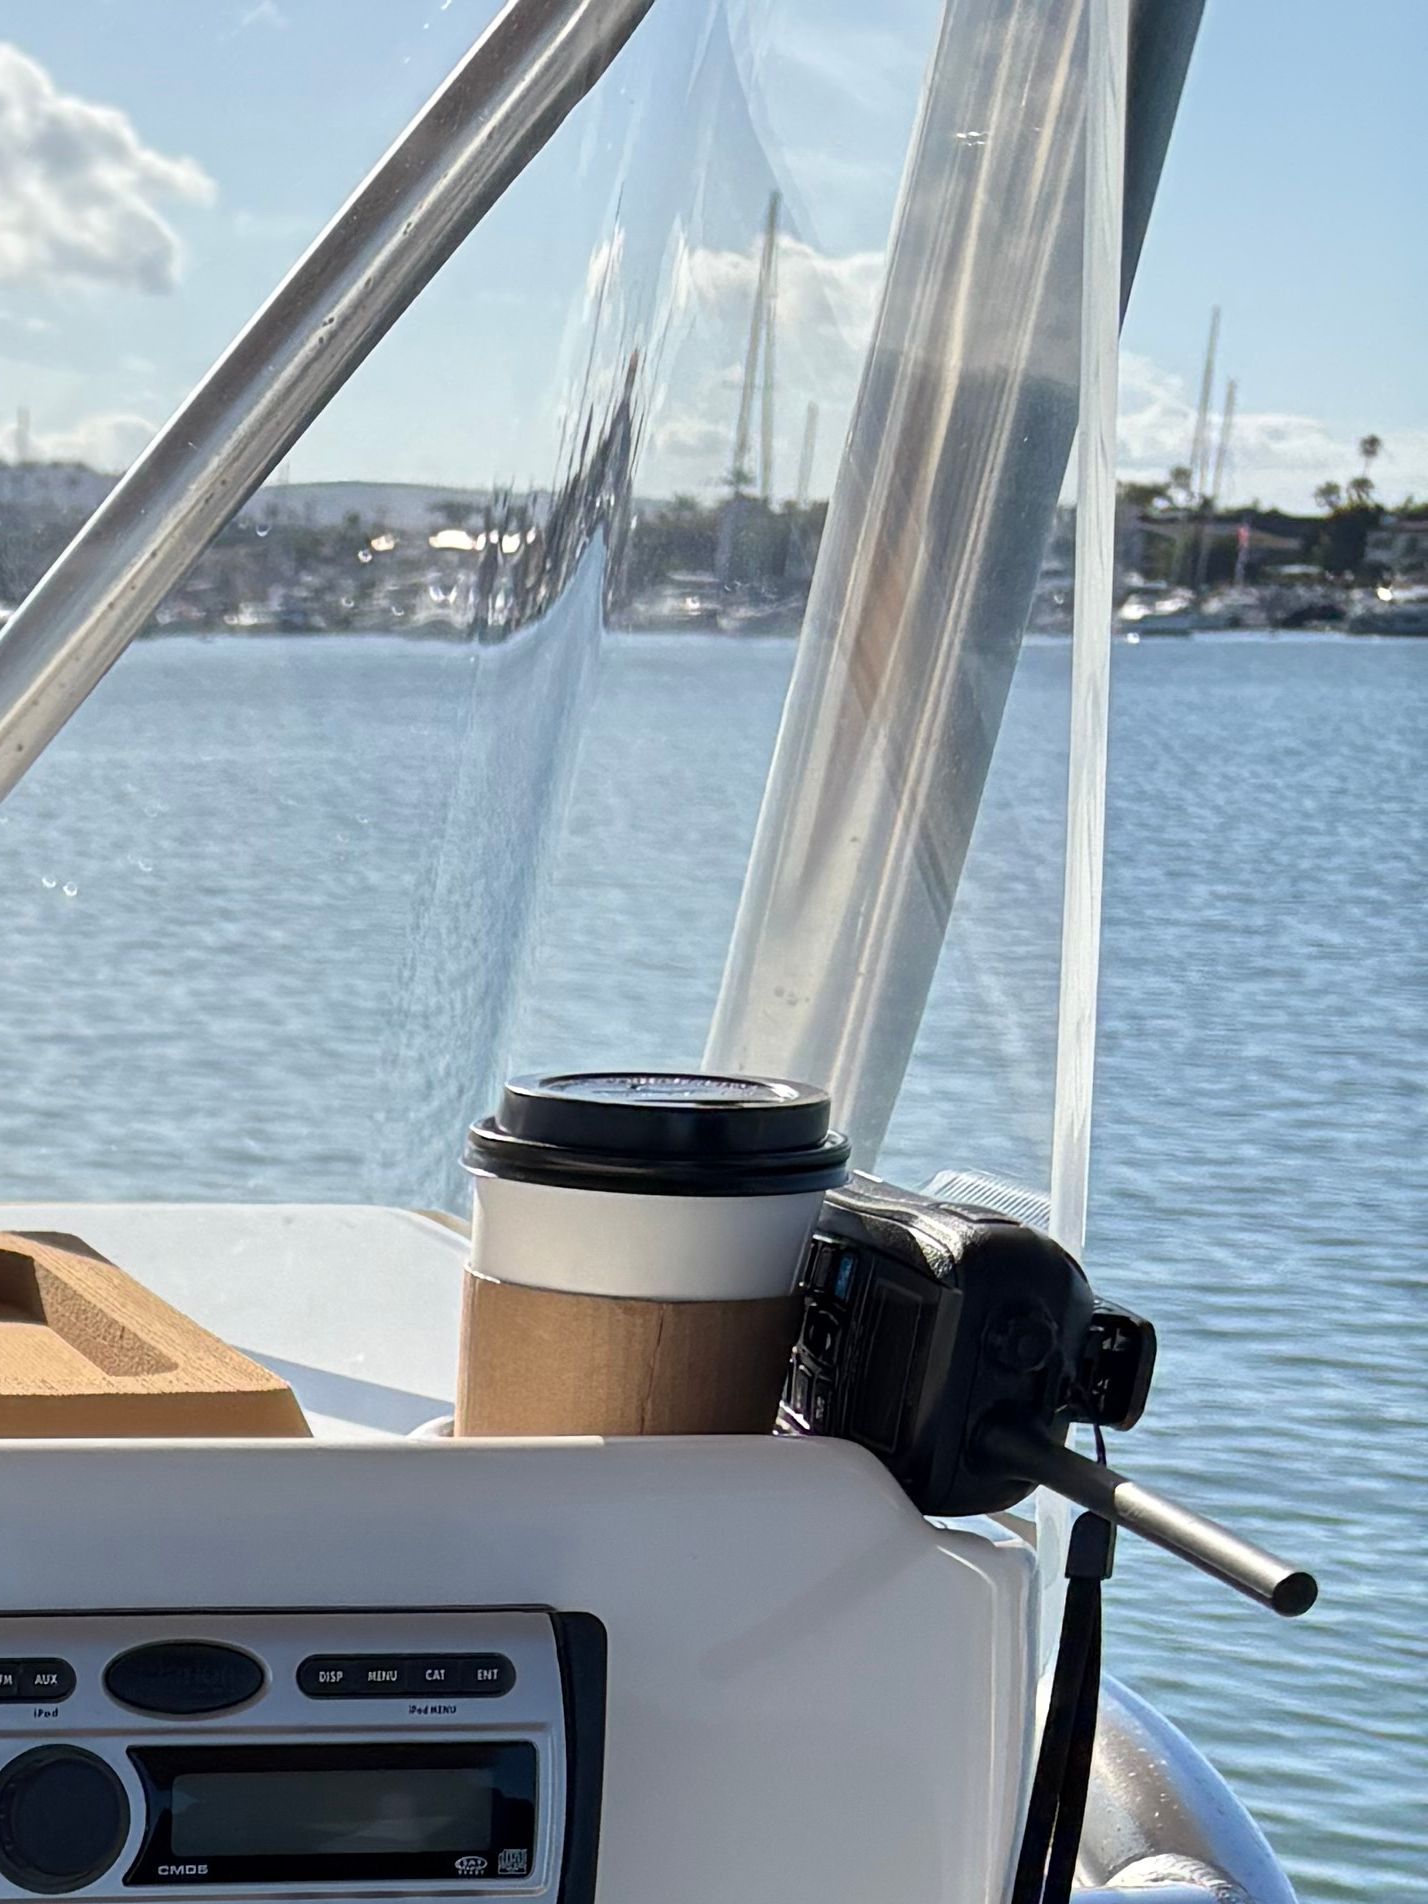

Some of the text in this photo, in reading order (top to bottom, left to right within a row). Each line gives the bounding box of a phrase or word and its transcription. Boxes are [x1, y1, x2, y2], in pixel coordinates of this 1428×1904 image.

[34, 1673, 58, 1686] AUX
[318, 1670, 344, 1683] DISP
[367, 1669, 398, 1682] MENU
[425, 1668, 446, 1681] CAT
[476, 1668, 498, 1681] ENT
